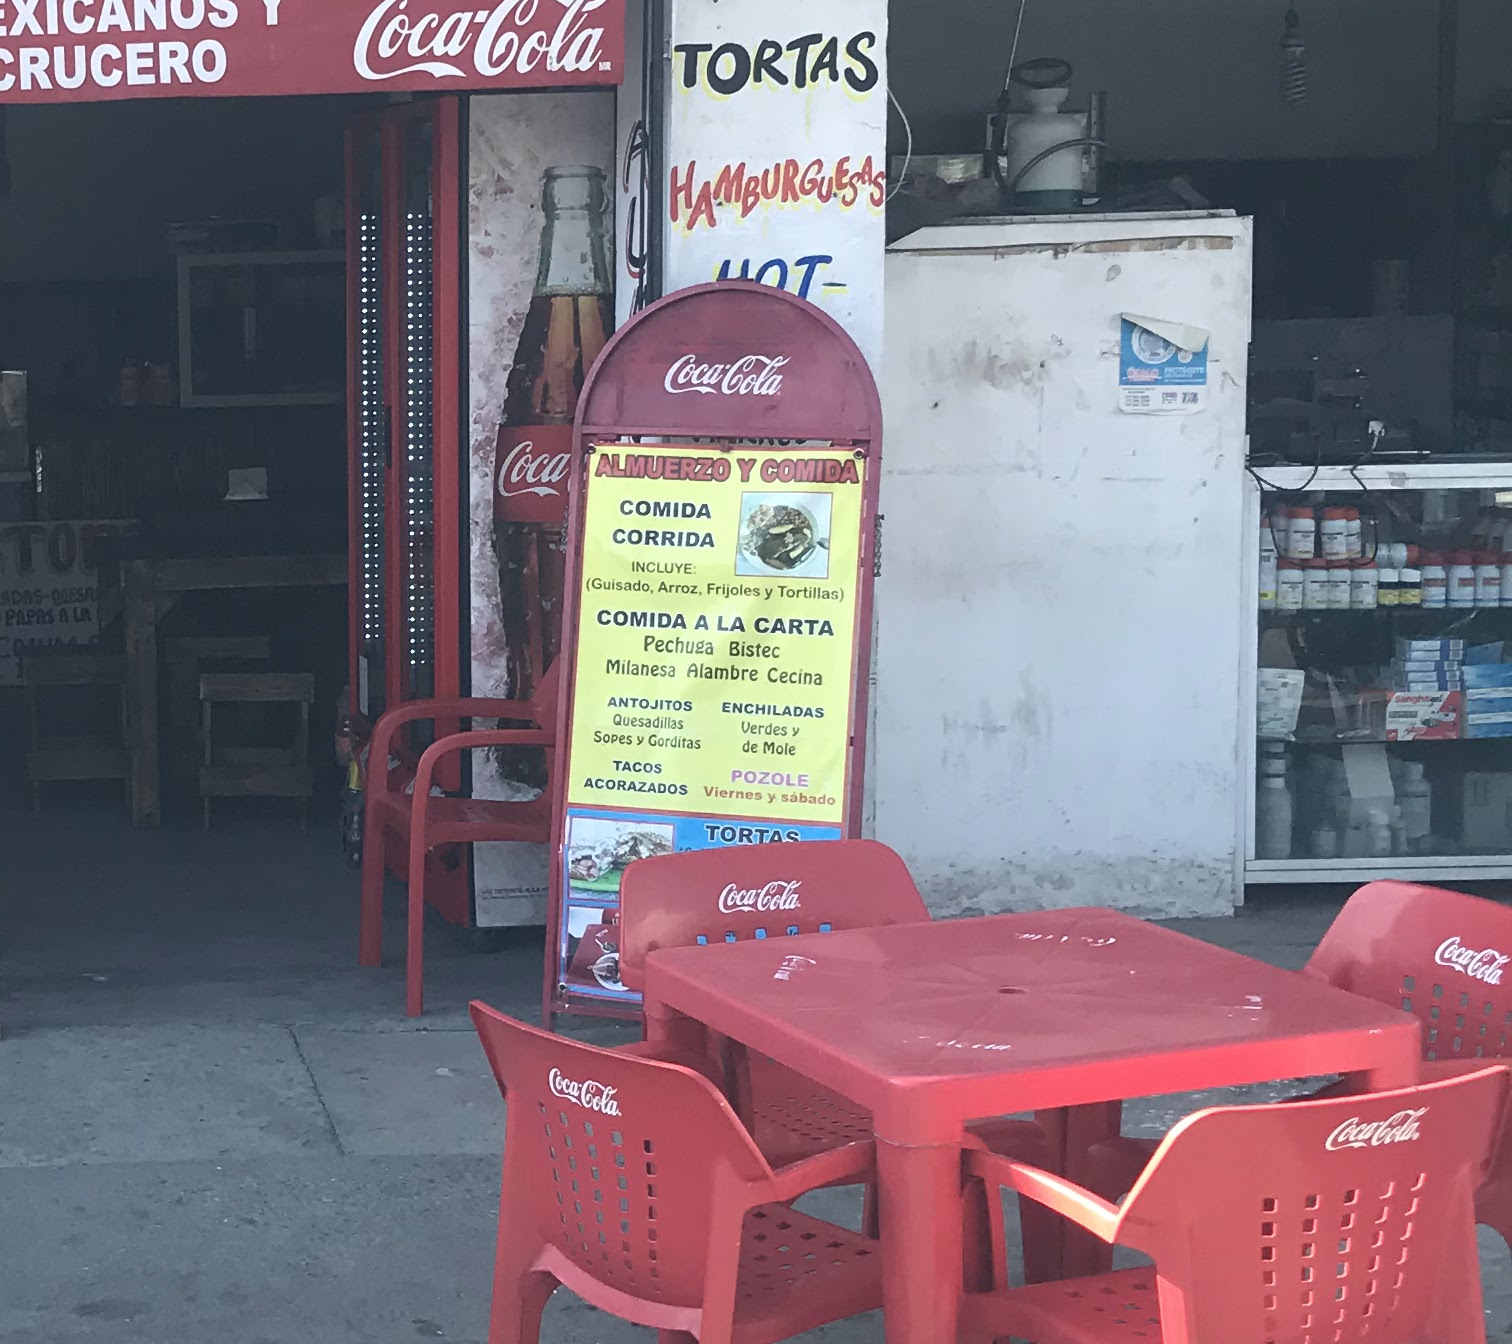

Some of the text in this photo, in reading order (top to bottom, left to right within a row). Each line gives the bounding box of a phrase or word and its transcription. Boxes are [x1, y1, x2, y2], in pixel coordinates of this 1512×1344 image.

[673, 30, 880, 96] TORTAS
[670, 154, 888, 233] HAMBURGUESAS
[664, 354, 792, 396] Coca-Cola
[594, 453, 860, 484] ALMUERZO Y COMIDA
[619, 500, 712, 519] COMIDA
[612, 528, 715, 549] CORRIDA
[631, 560, 697, 576] INCLUYE:
[585, 578, 845, 603] (Guisado, Arroz, Frijoles y Tortillas)
[596, 609, 835, 637] COMIDA A LA CARTA
[643, 635, 781, 659] Pechuga Bistec
[606, 659, 823, 687] Milanesa Alambre Cecina
[606, 696, 694, 713] ANTOJITOS
[721, 701, 825, 720] ENCHILADAS
[612, 713, 684, 731] Quesadillas
[740, 720, 801, 738] Verdes y
[592, 730, 702, 751] Sopes y Gorditas
[741, 740, 797, 757] de Mole
[612, 760, 663, 775] TACOS
[583, 777, 689, 796] ACORAZADOS
[730, 769, 810, 788] POZOLE
[703, 785, 836, 807] Viernes y sábado
[704, 824, 801, 845] TORTAS
[719, 880, 802, 914] Coca-Cola
[1434, 936, 1511, 986] Coca-Cola
[548, 1067, 623, 1117] Coca-Cola
[1325, 1106, 1431, 1151] Coca-Cola
